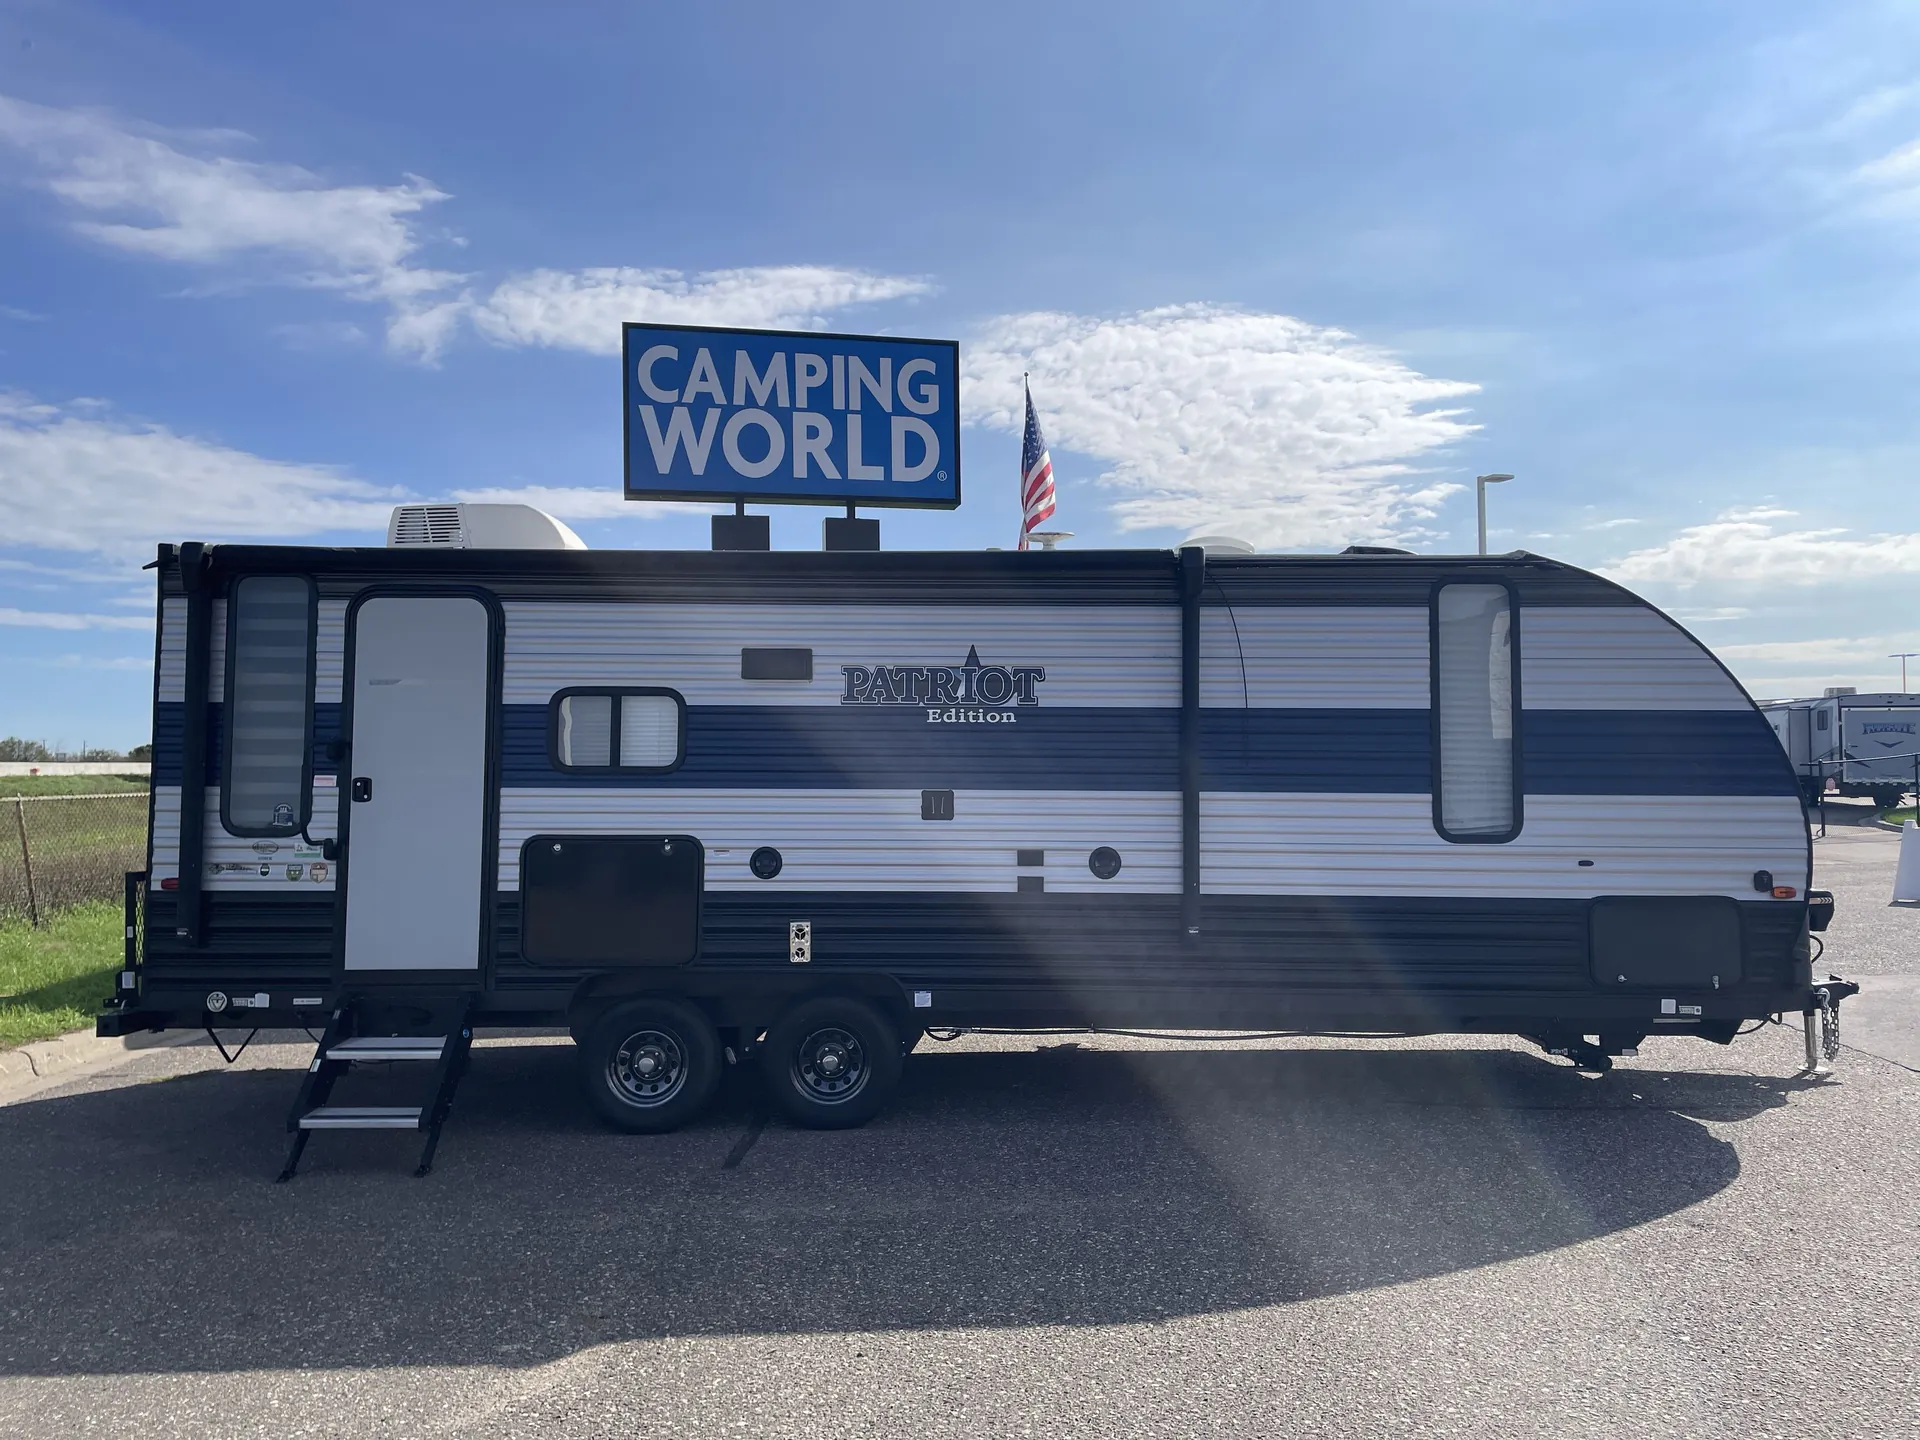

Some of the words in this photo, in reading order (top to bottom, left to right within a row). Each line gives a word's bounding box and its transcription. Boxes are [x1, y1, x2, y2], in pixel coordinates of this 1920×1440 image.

[637, 344, 940, 415] CAMPING
[638, 404, 941, 482] WORLD
[840, 664, 1046, 706] PATRIOT
[926, 708, 1017, 724] Edition
